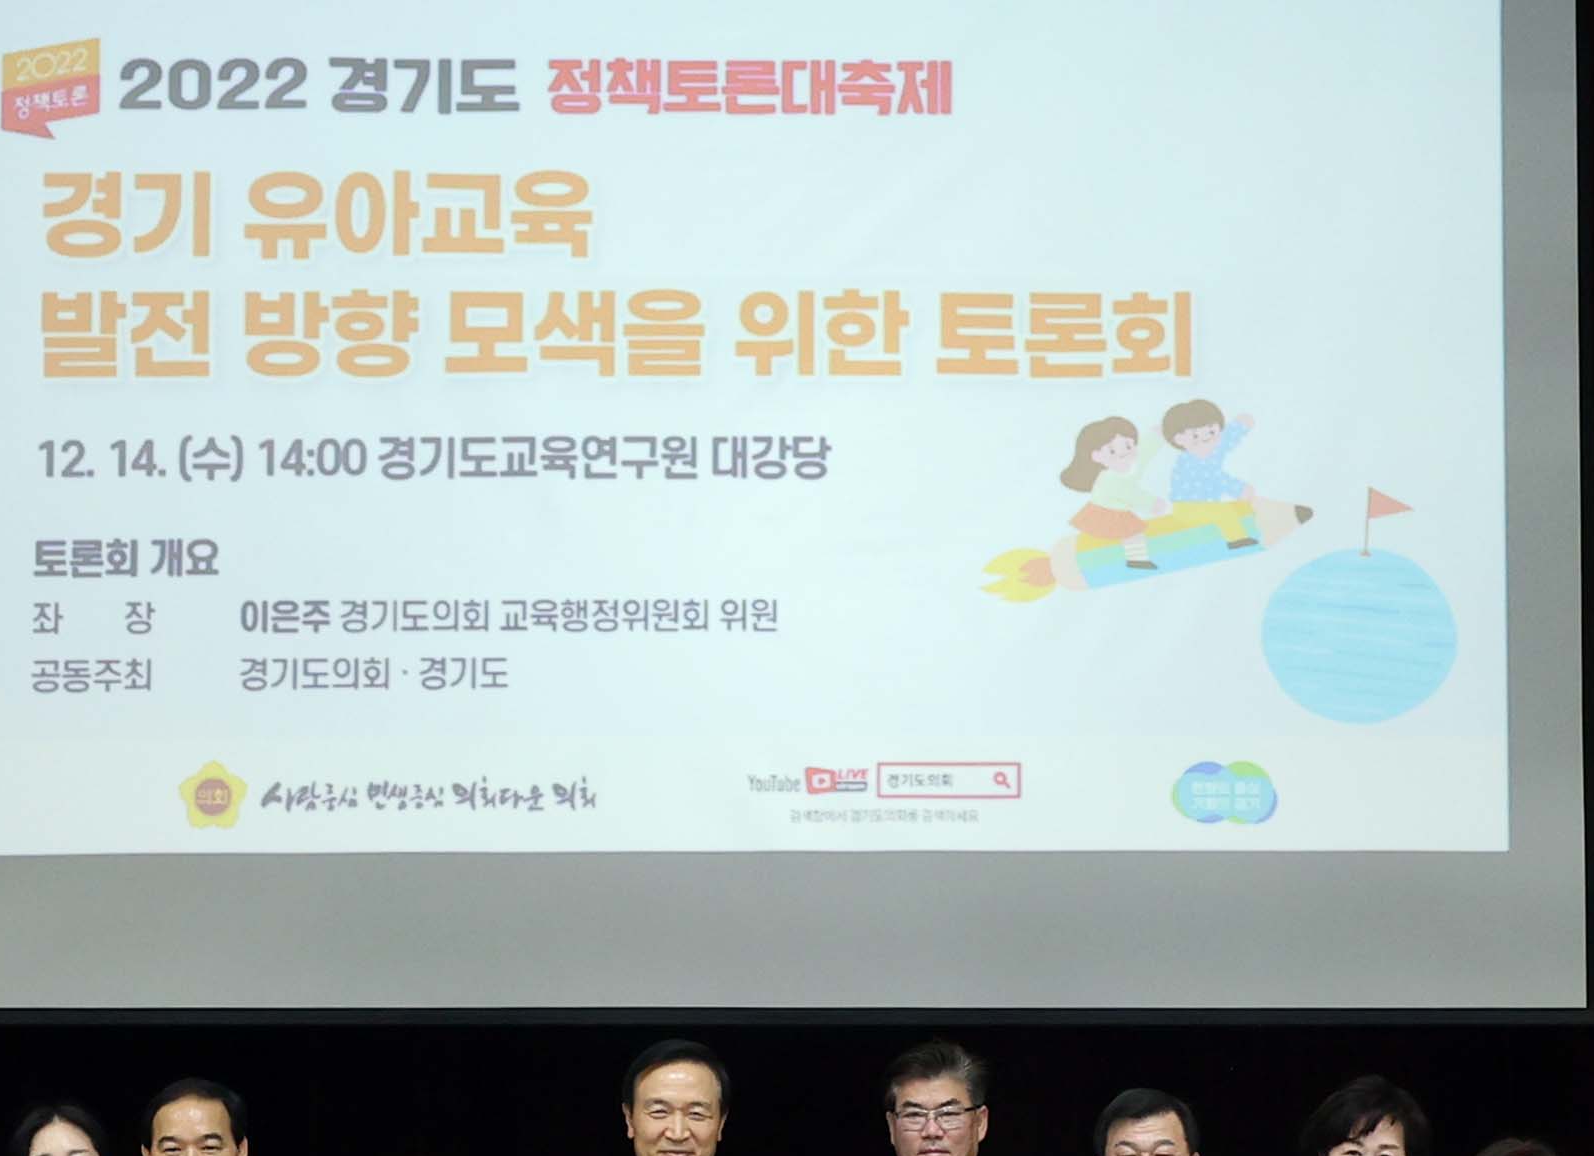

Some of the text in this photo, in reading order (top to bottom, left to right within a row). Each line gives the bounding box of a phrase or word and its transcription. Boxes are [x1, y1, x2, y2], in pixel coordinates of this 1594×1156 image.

[16, 47, 89, 81] 2022
[119, 57, 952, 116] 2022 경기도 정책토론대축제
[43, 170, 593, 260] 경기 유아교육
[41, 288, 1192, 378] 발전 방향 모색을 위한 토론회
[39, 435, 832, 482] 12. 14. (수) 14:00 경기도교육연구원 대강당
[33, 538, 219, 578] 토론회 개요
[241, 599, 777, 633] 이은주 경기도의회 교육행정위원회 위원
[31, 658, 151, 693] 공동주최
[240, 657, 389, 691] 경기도의회
[419, 657, 508, 690] 경기도
[261, 776, 596, 812] 사람중심 민생중심 의회다운 의회
[747, 774, 800, 793] YouTube
